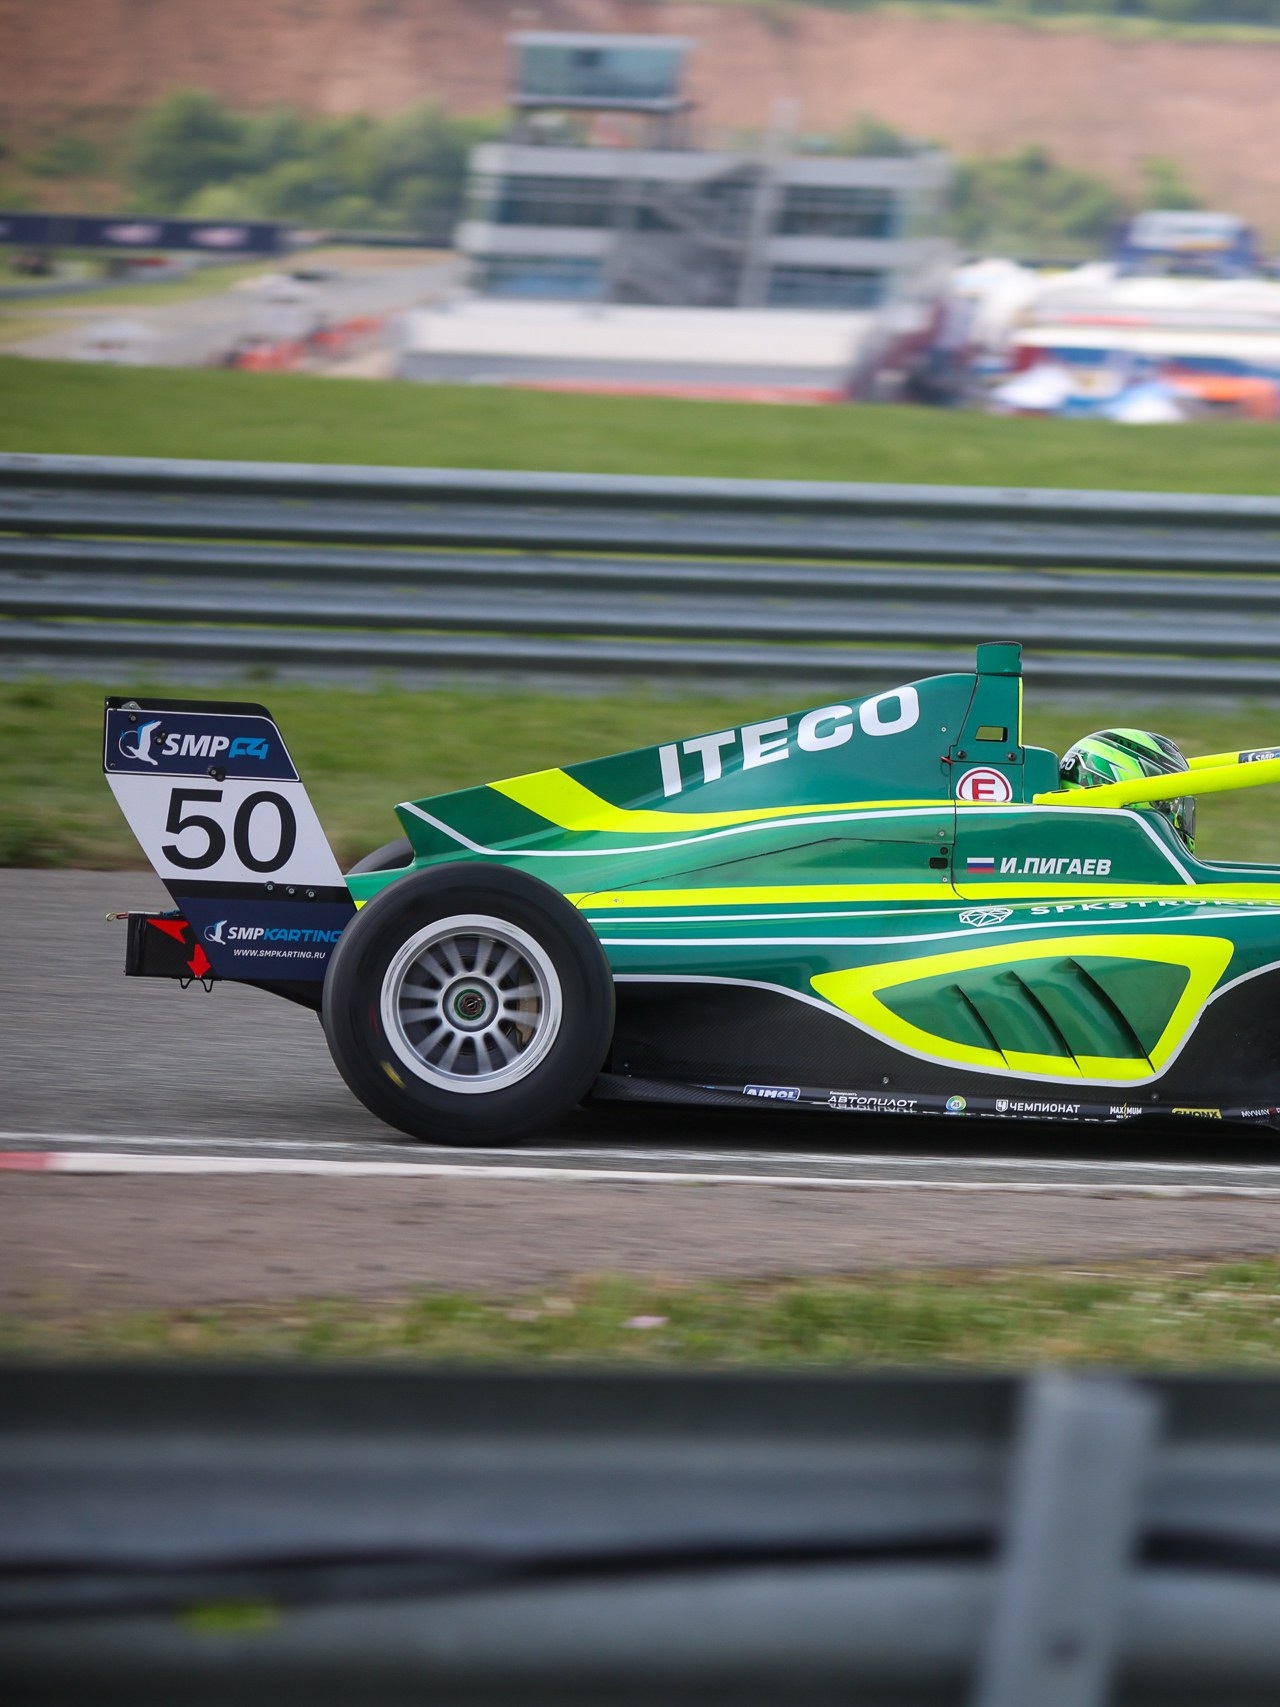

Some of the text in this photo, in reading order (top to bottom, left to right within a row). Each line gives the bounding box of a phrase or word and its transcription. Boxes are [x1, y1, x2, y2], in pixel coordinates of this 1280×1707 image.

[659, 686, 920, 797] ITECO
[971, 778, 998, 802] E
[161, 788, 298, 873] 50
[1000, 857, 1112, 876] И.ПИГАЕВ
[233, 948, 326, 959] WWW.SMPKARTING.RU
[1009, 1102, 1081, 1113] ЧЕМПИОНАТ
